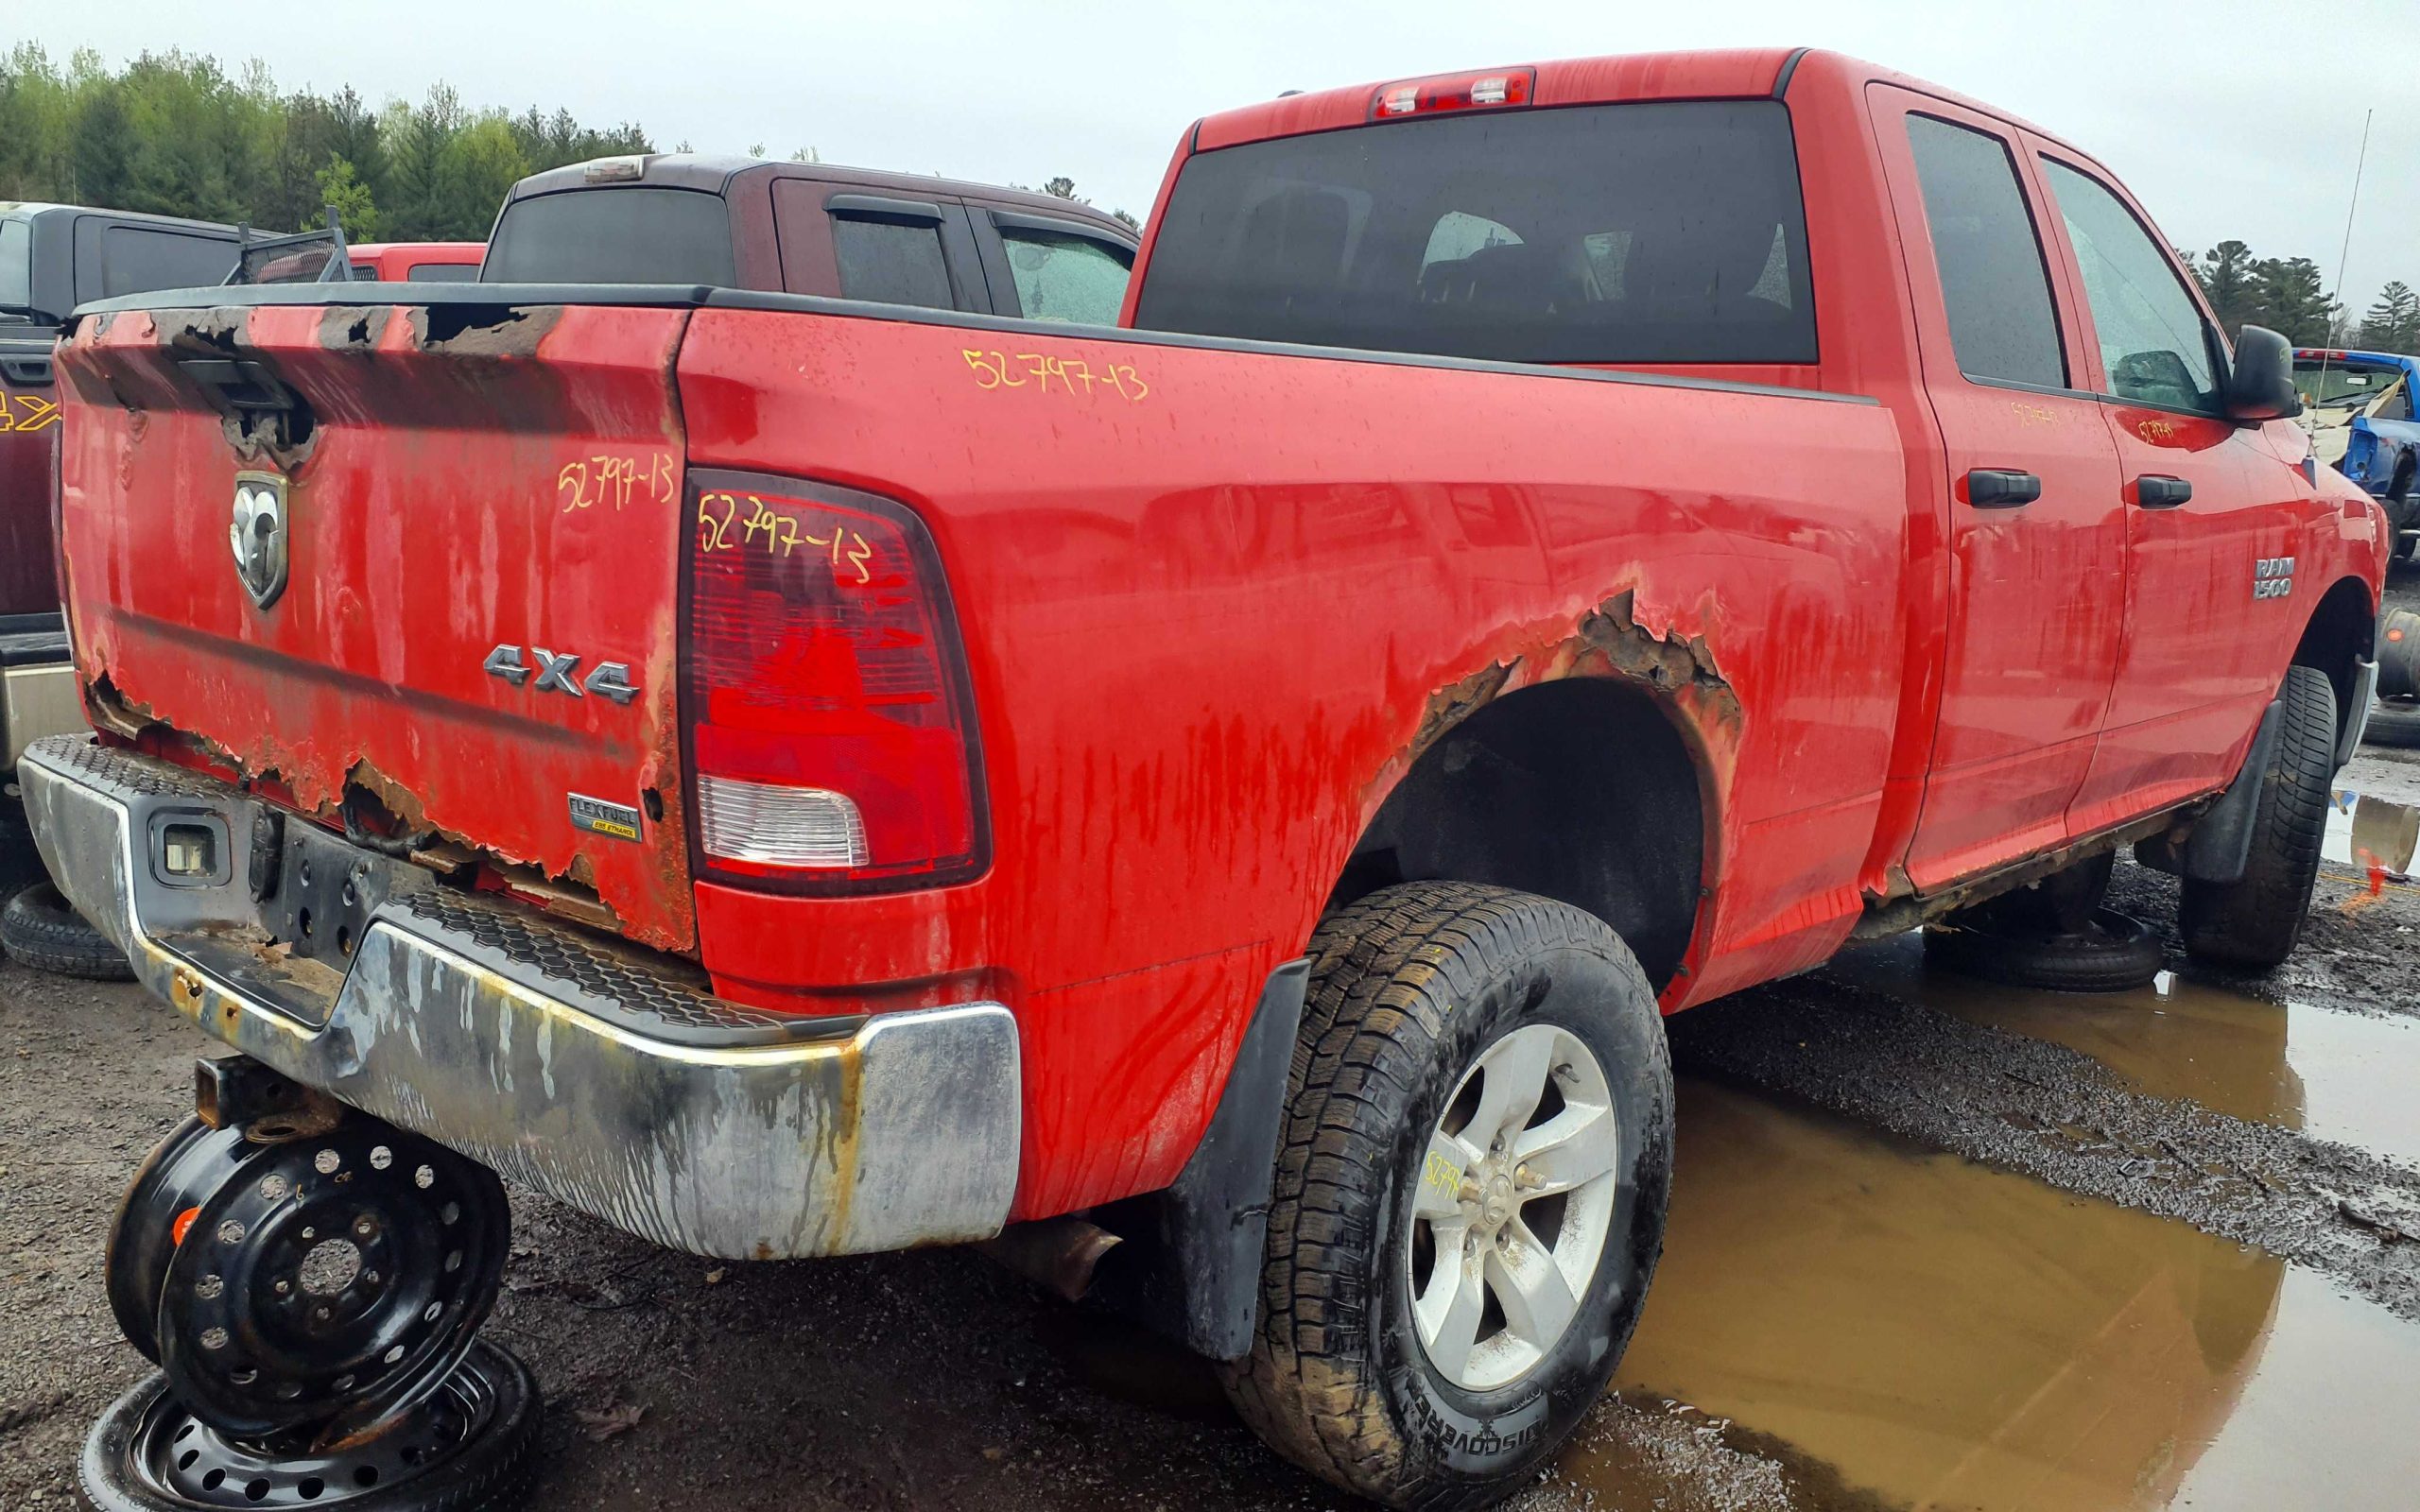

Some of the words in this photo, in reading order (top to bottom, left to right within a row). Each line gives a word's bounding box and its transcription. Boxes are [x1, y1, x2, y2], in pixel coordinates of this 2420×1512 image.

[962, 349, 1149, 401] 52797-13
[558, 453, 674, 513] 52797-13
[698, 494, 872, 584] 52797-13
[2253, 577, 2292, 599] 1500
[2256, 558, 2295, 577] RAM
